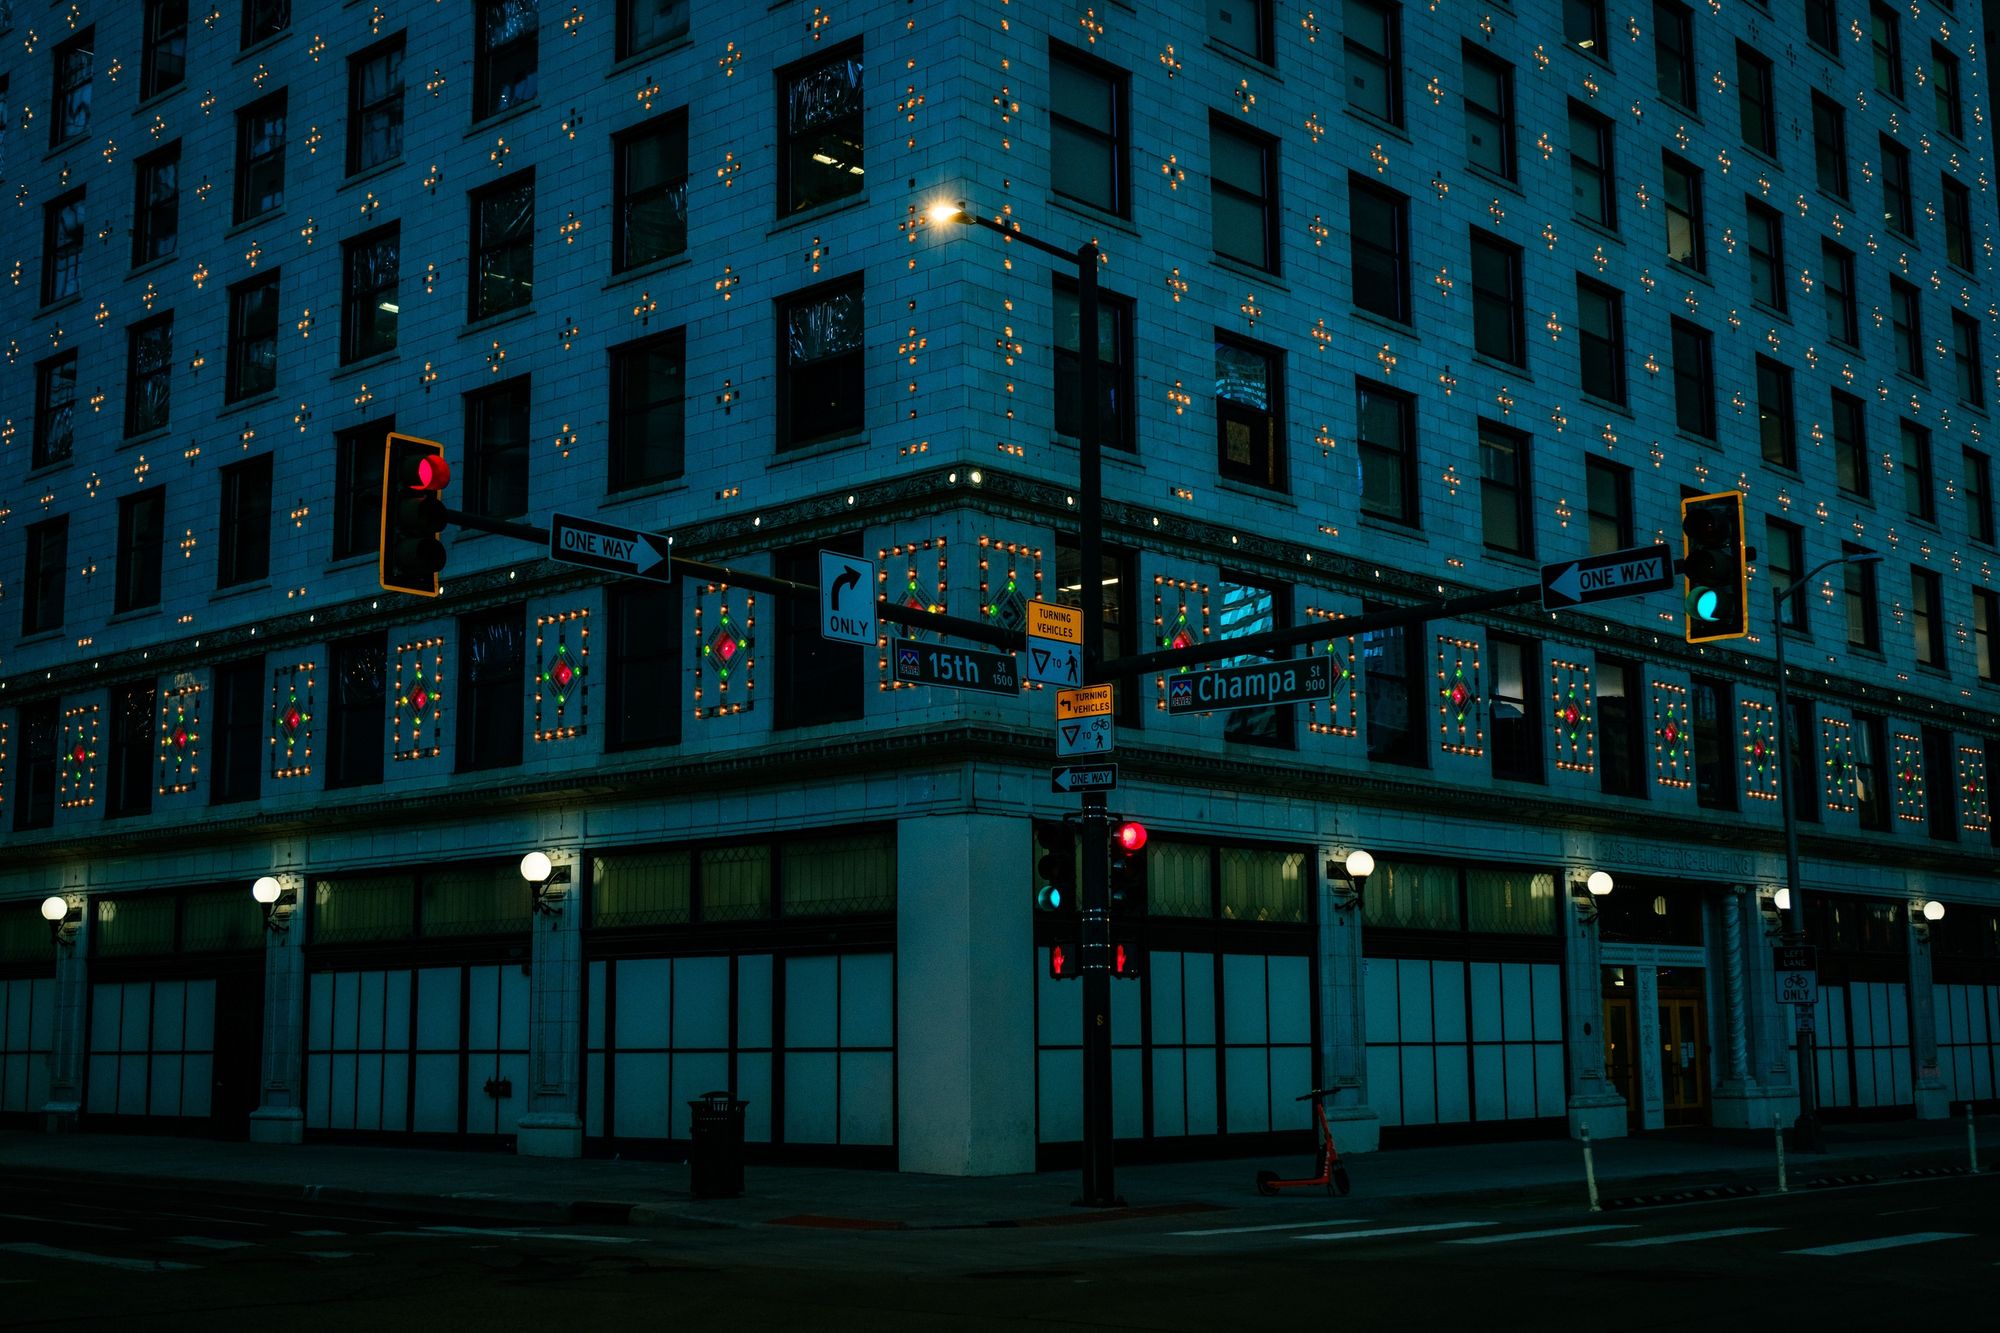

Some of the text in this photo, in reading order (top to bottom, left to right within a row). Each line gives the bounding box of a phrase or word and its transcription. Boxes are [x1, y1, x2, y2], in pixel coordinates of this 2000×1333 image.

[565, 530, 634, 560] ONE WAY
[1580, 560, 1657, 590] ONE WAY
[1039, 608, 1072, 623] TURNING
[830, 615, 869, 637] ONLY
[1037, 623, 1073, 638] VEHICLES
[928, 651, 1007, 684] 15th St
[1052, 657, 1062, 669] TO
[992, 673, 1013, 687] 1500
[1198, 664, 1320, 701] Champa St
[1305, 678, 1326, 692] 900
[1075, 690, 1108, 702] TURNING
[1073, 702, 1110, 714] VEHICLES
[1082, 731, 1092, 740] TO
[1070, 770, 1110, 785] ONE WAY
[1783, 989, 1809, 1001] ONLY
